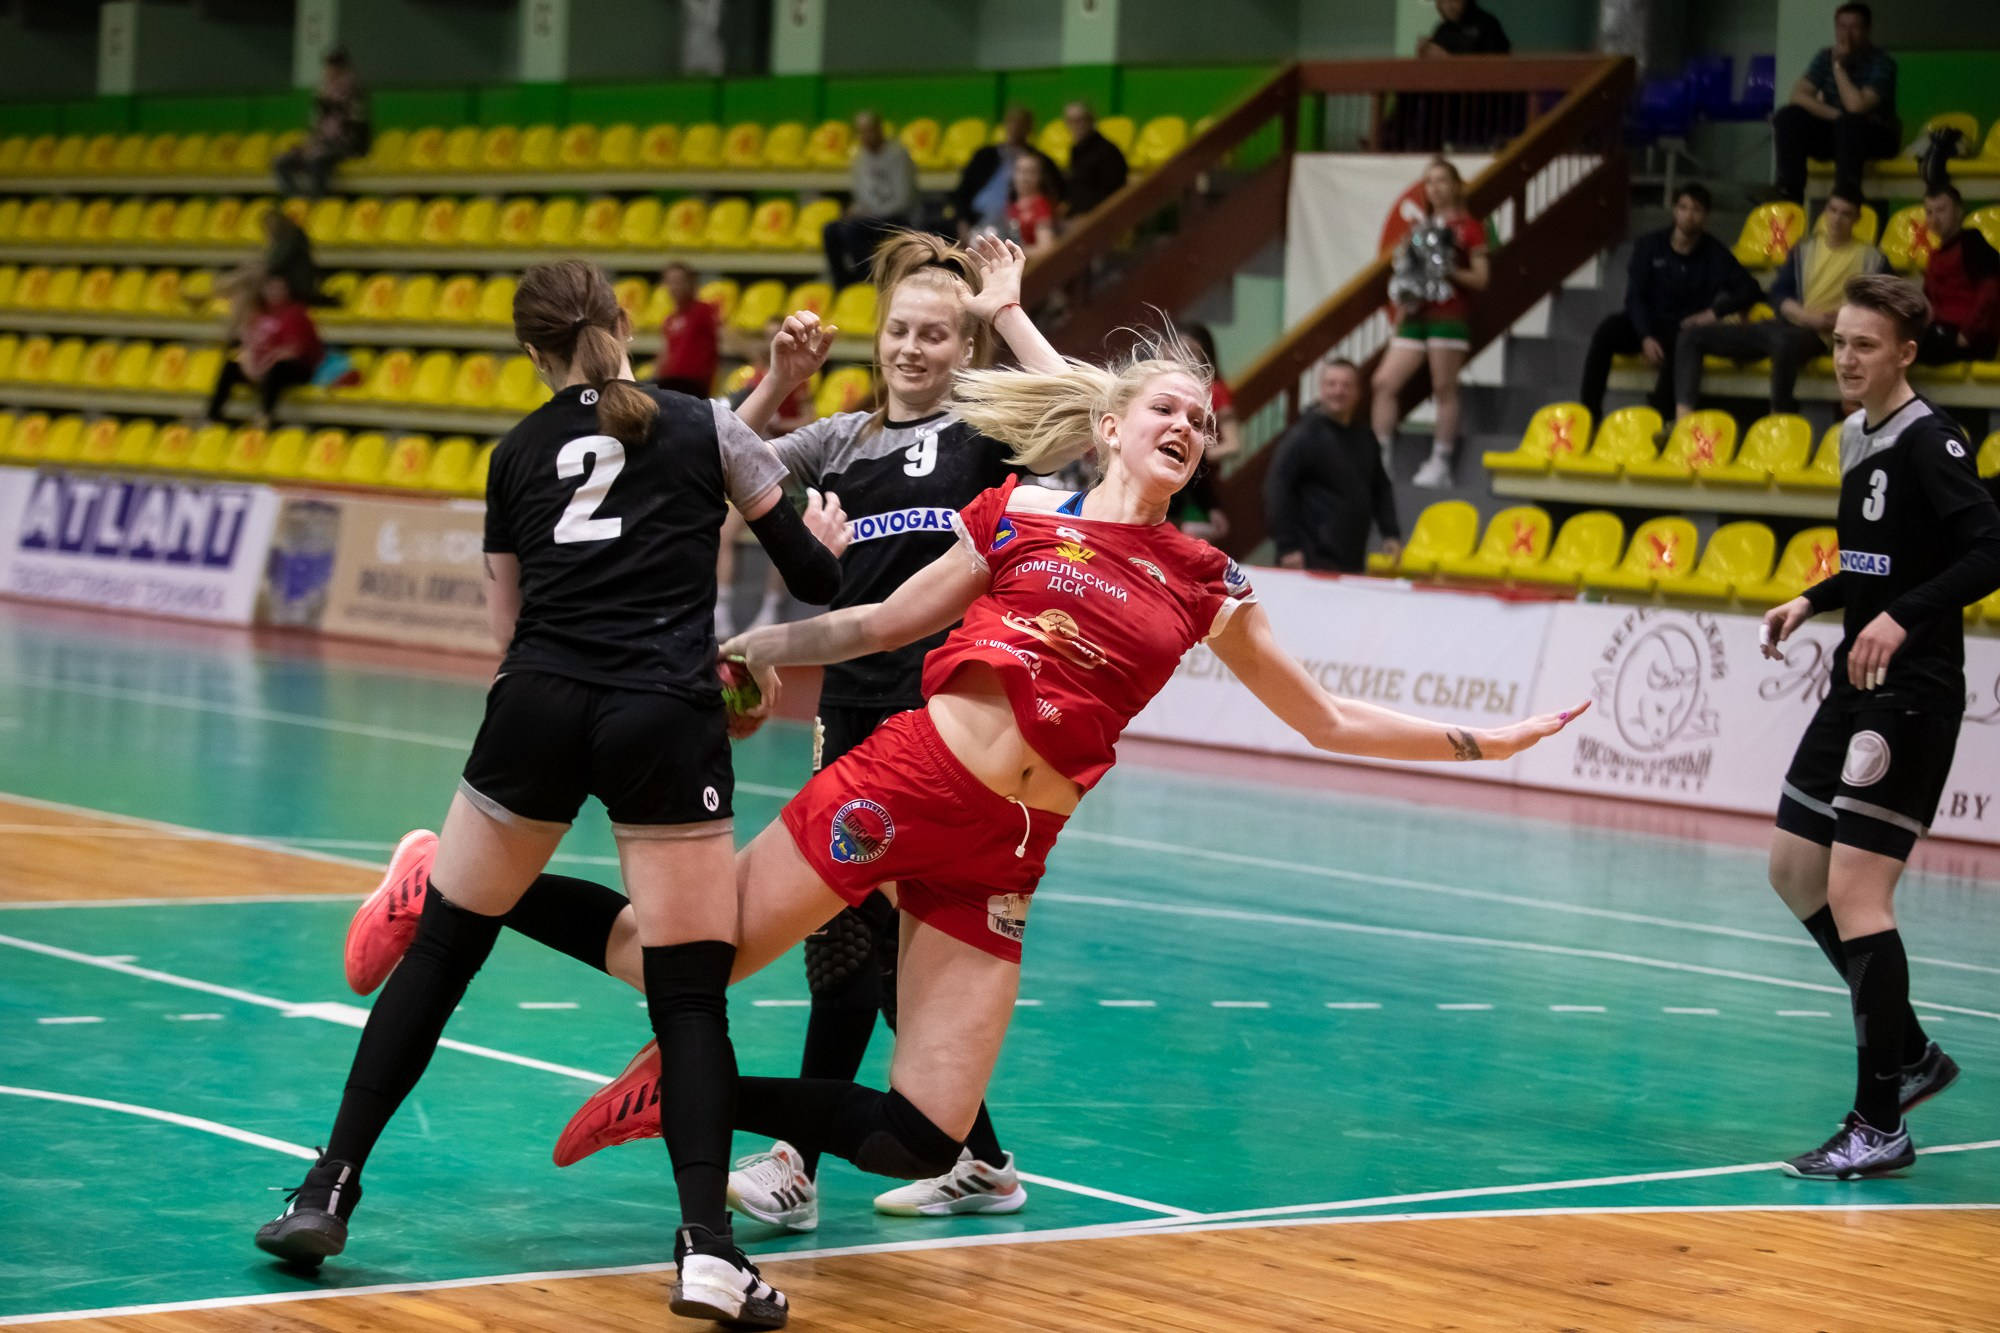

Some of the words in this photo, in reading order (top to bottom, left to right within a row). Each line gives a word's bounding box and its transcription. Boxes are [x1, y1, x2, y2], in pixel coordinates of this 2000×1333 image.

[903, 432, 939, 477] 9
[554, 435, 626, 544] 2
[1862, 469, 1888, 521] 3
[19, 473, 254, 568] ATLANT
[1015, 560, 1129, 603] ГОМЕЛЬСКИЙ
[1047, 576, 1087, 598] ДСК
[1413, 672, 1520, 715] СЫРЫ
